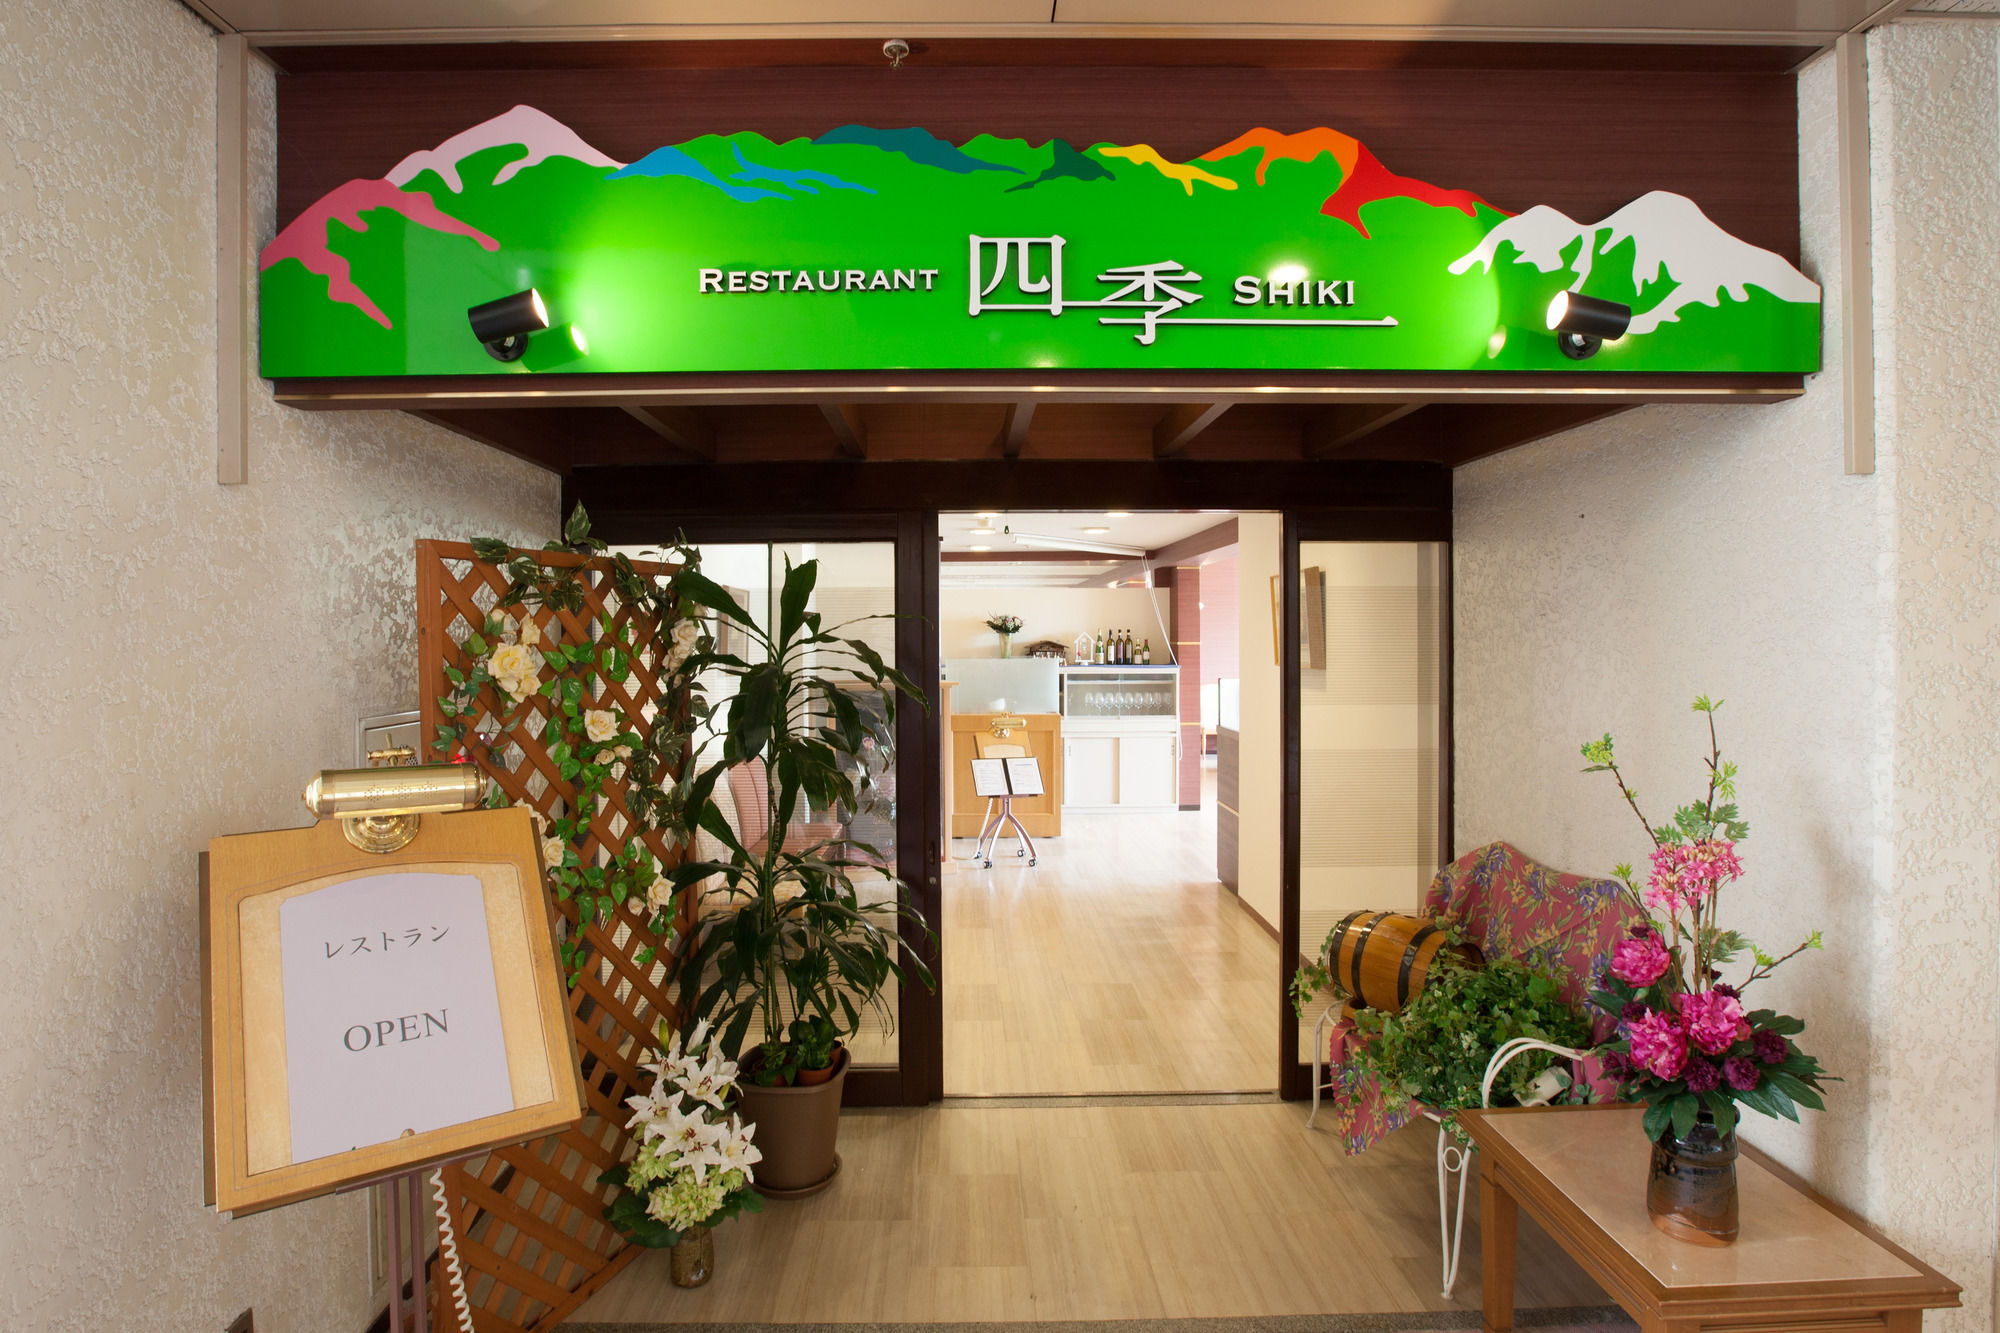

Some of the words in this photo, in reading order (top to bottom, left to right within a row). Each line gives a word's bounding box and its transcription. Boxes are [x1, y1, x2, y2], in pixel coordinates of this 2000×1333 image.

[699, 267, 939, 293] RESTAURANT
[968, 233, 1205, 346] 四季
[1233, 275, 1356, 307] SHIKI
[324, 926, 450, 959] レストラン
[343, 1008, 449, 1052] OPEN
